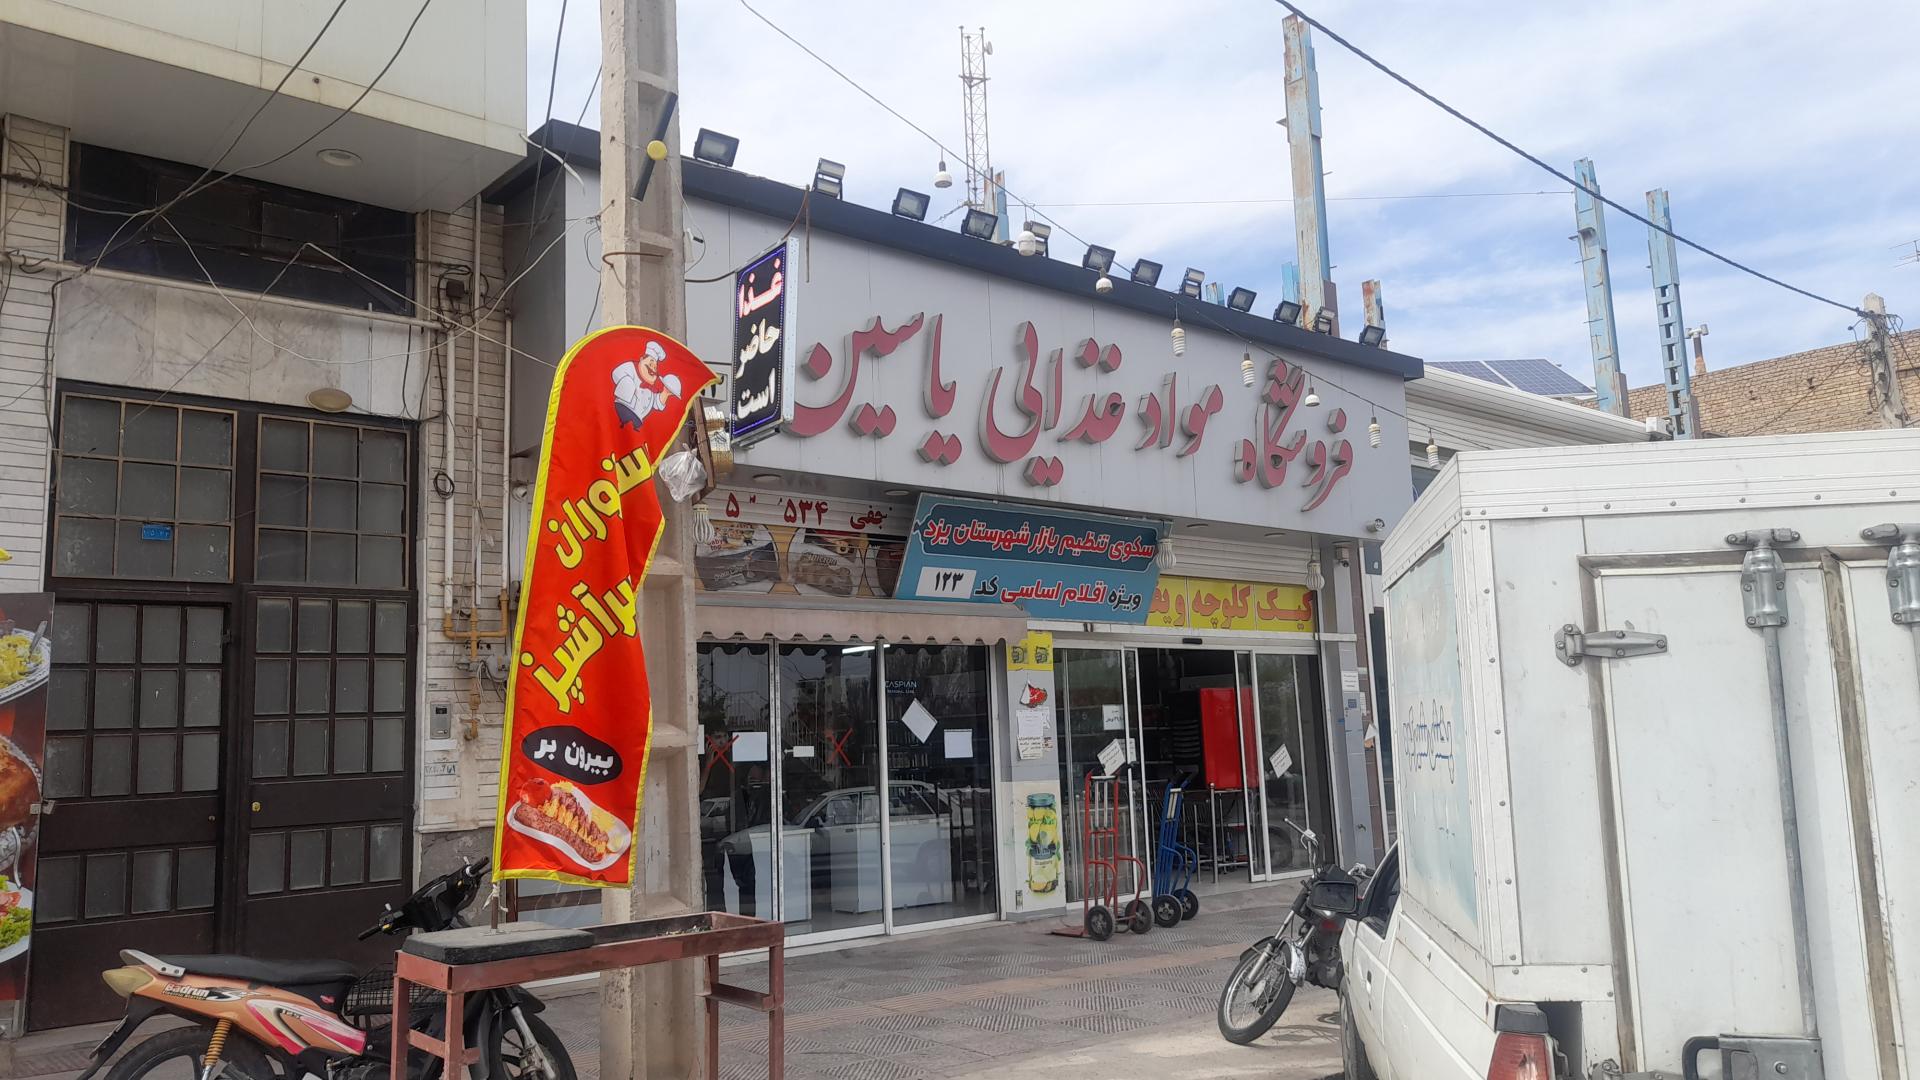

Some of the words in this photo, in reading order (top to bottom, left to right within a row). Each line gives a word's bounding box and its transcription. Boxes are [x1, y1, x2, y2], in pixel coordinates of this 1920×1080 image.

[738, 258, 783, 318] غذا
[736, 318, 780, 379] حاضر
[737, 367, 776, 420] است
[783, 311, 963, 466] یاسین
[1134, 372, 1224, 458] مواد
[1234, 359, 1354, 512] فروشگاه
[850, 505, 892, 529] نجفی
[923, 519, 953, 546] یزد
[952, 520, 1030, 550] شهرستان
[1028, 526, 1059, 554] بازار
[1058, 533, 1110, 555] تنظیم
[1109, 536, 1156, 562] سکوی
[935, 571, 964, 592] ۱۲۳
[974, 576, 999, 597] کد
[1000, 580, 1061, 603] اساسی
[1061, 580, 1107, 606] اقلام
[1108, 583, 1143, 612] ویژه
[1192, 584, 1250, 629] کلوچه
[534, 739, 557, 760] بر
